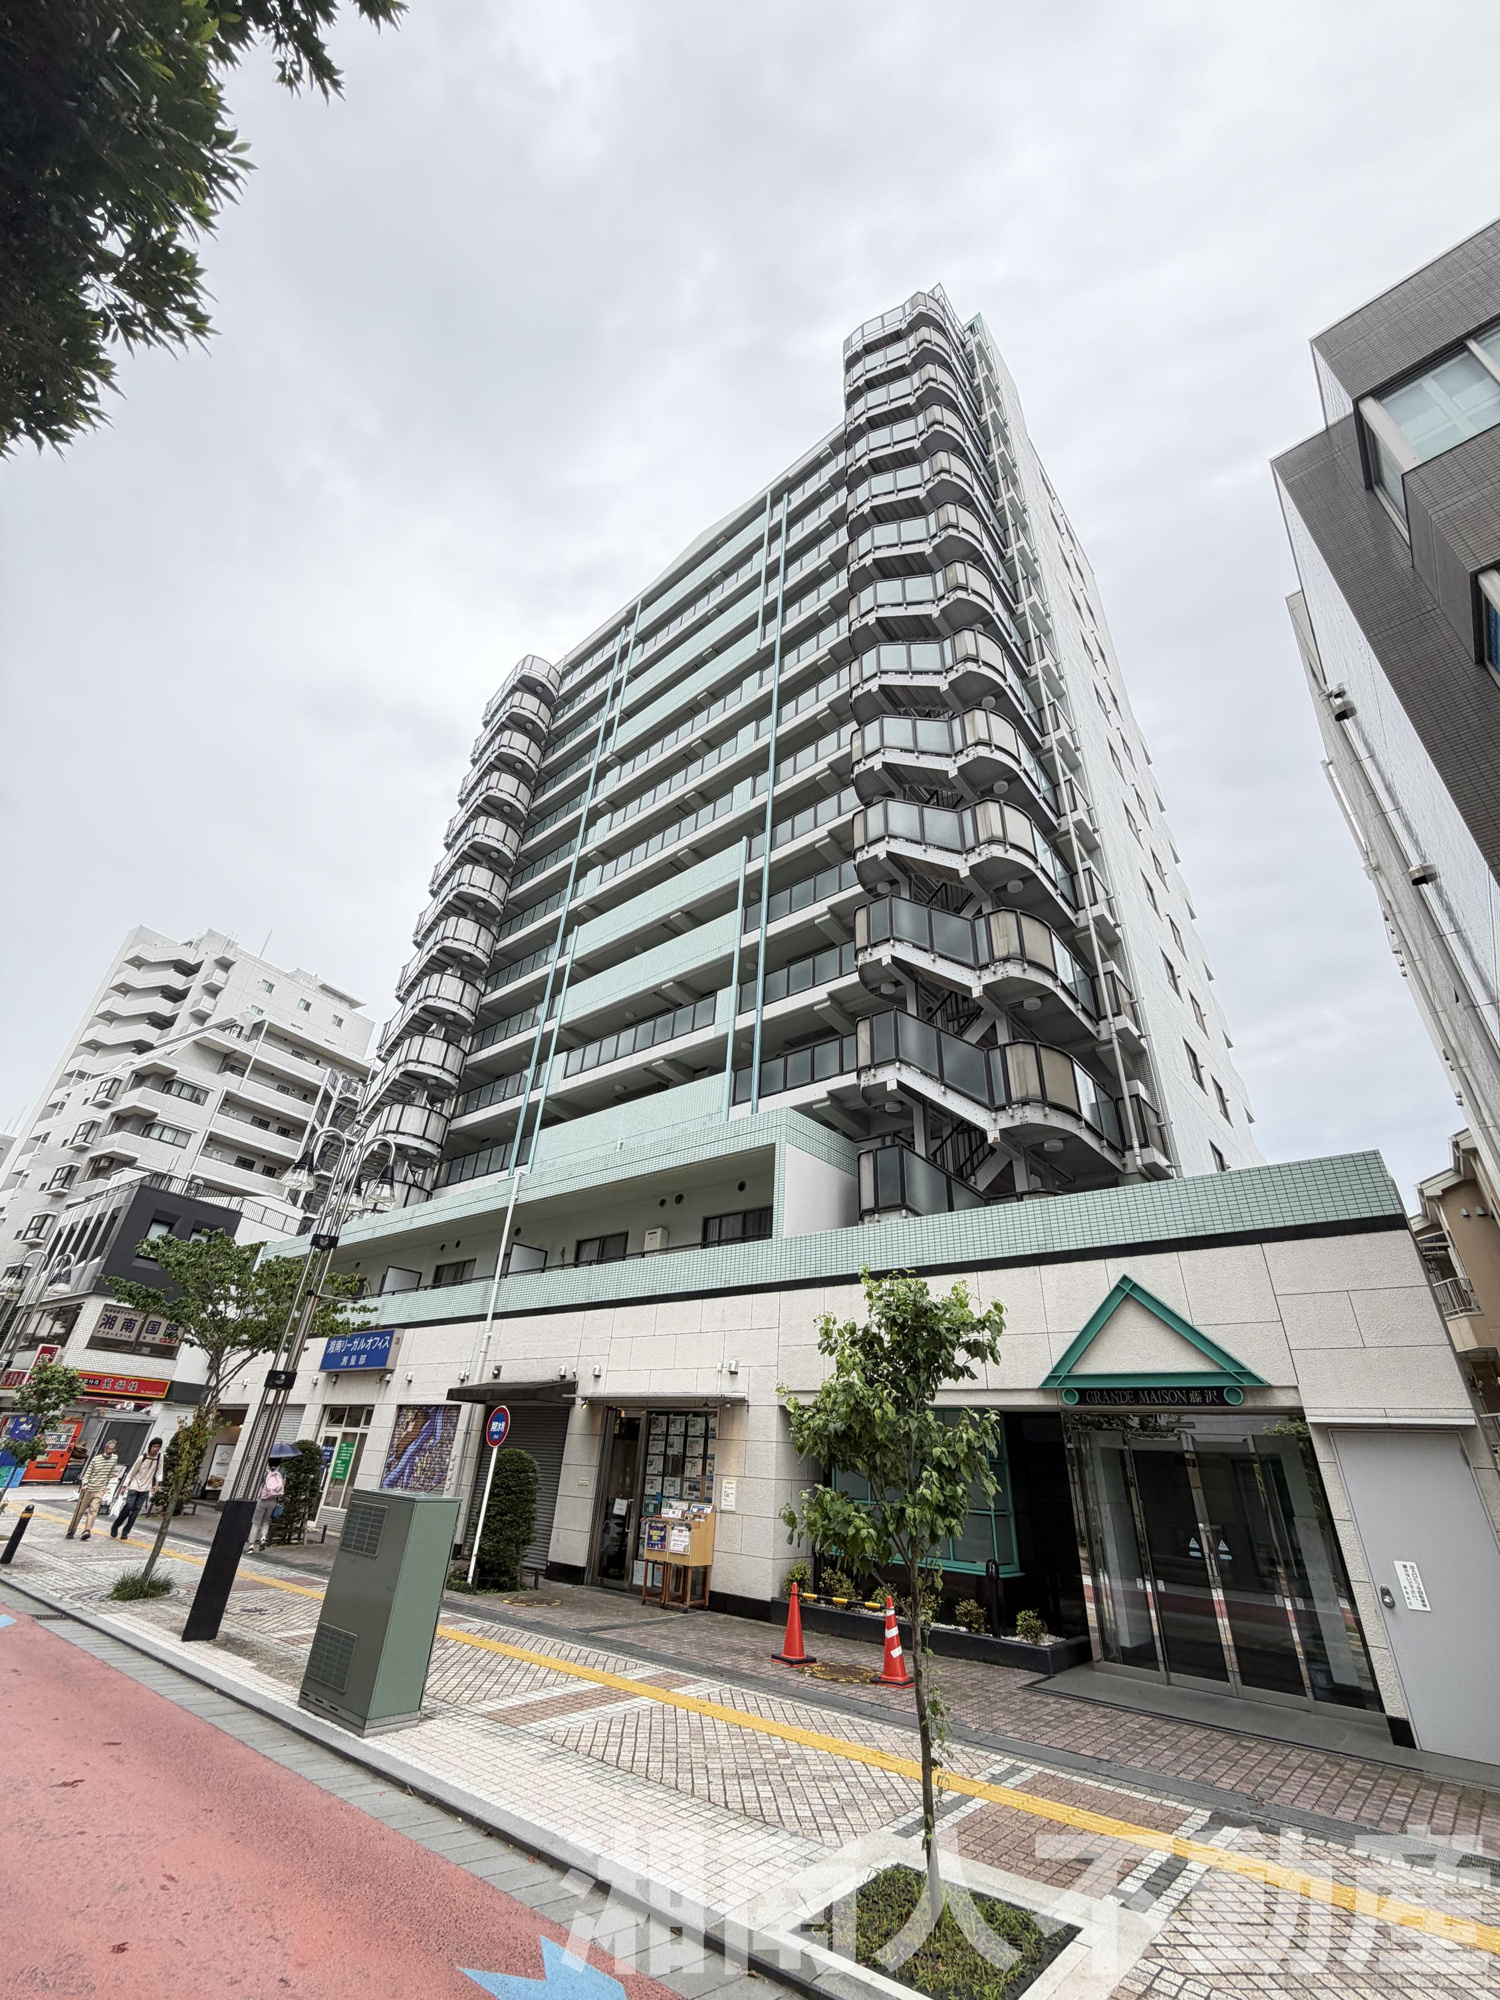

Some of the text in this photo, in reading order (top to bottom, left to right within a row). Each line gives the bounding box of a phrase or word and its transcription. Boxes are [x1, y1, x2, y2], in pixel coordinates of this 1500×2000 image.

[327, 1335, 391, 1354] 湘南リーガルオフィス
[340, 1354, 367, 1366] 測量部
[1085, 1389, 1220, 1404] GRANDE MAISON 藤沢
